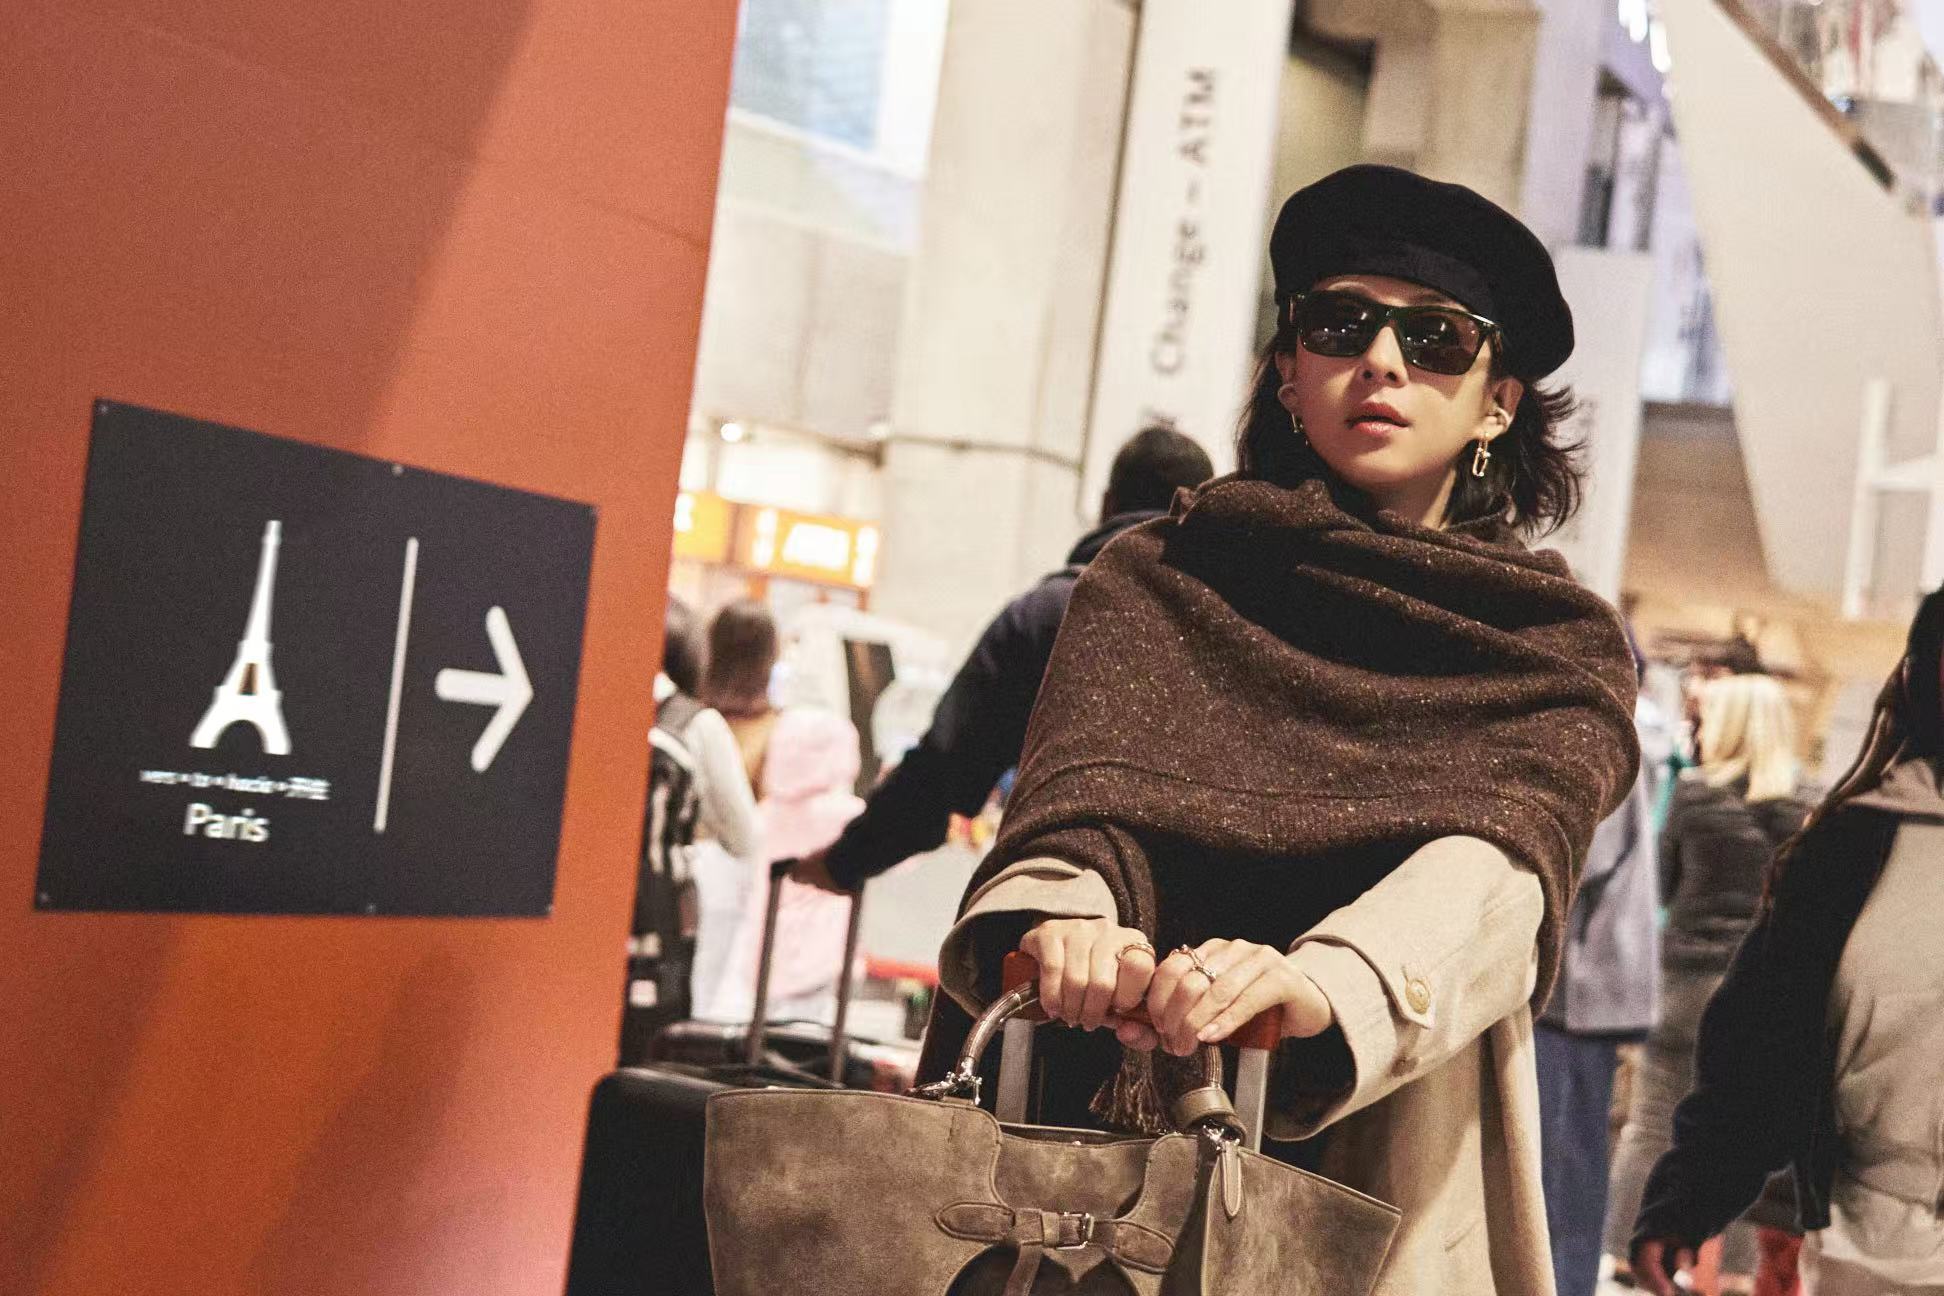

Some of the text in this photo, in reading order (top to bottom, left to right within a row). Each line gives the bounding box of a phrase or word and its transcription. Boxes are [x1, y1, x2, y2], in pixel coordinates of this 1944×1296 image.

[1177, 67, 1216, 165] ATM
[1150, 219, 1206, 376] Change
[183, 802, 270, 842] Paris
